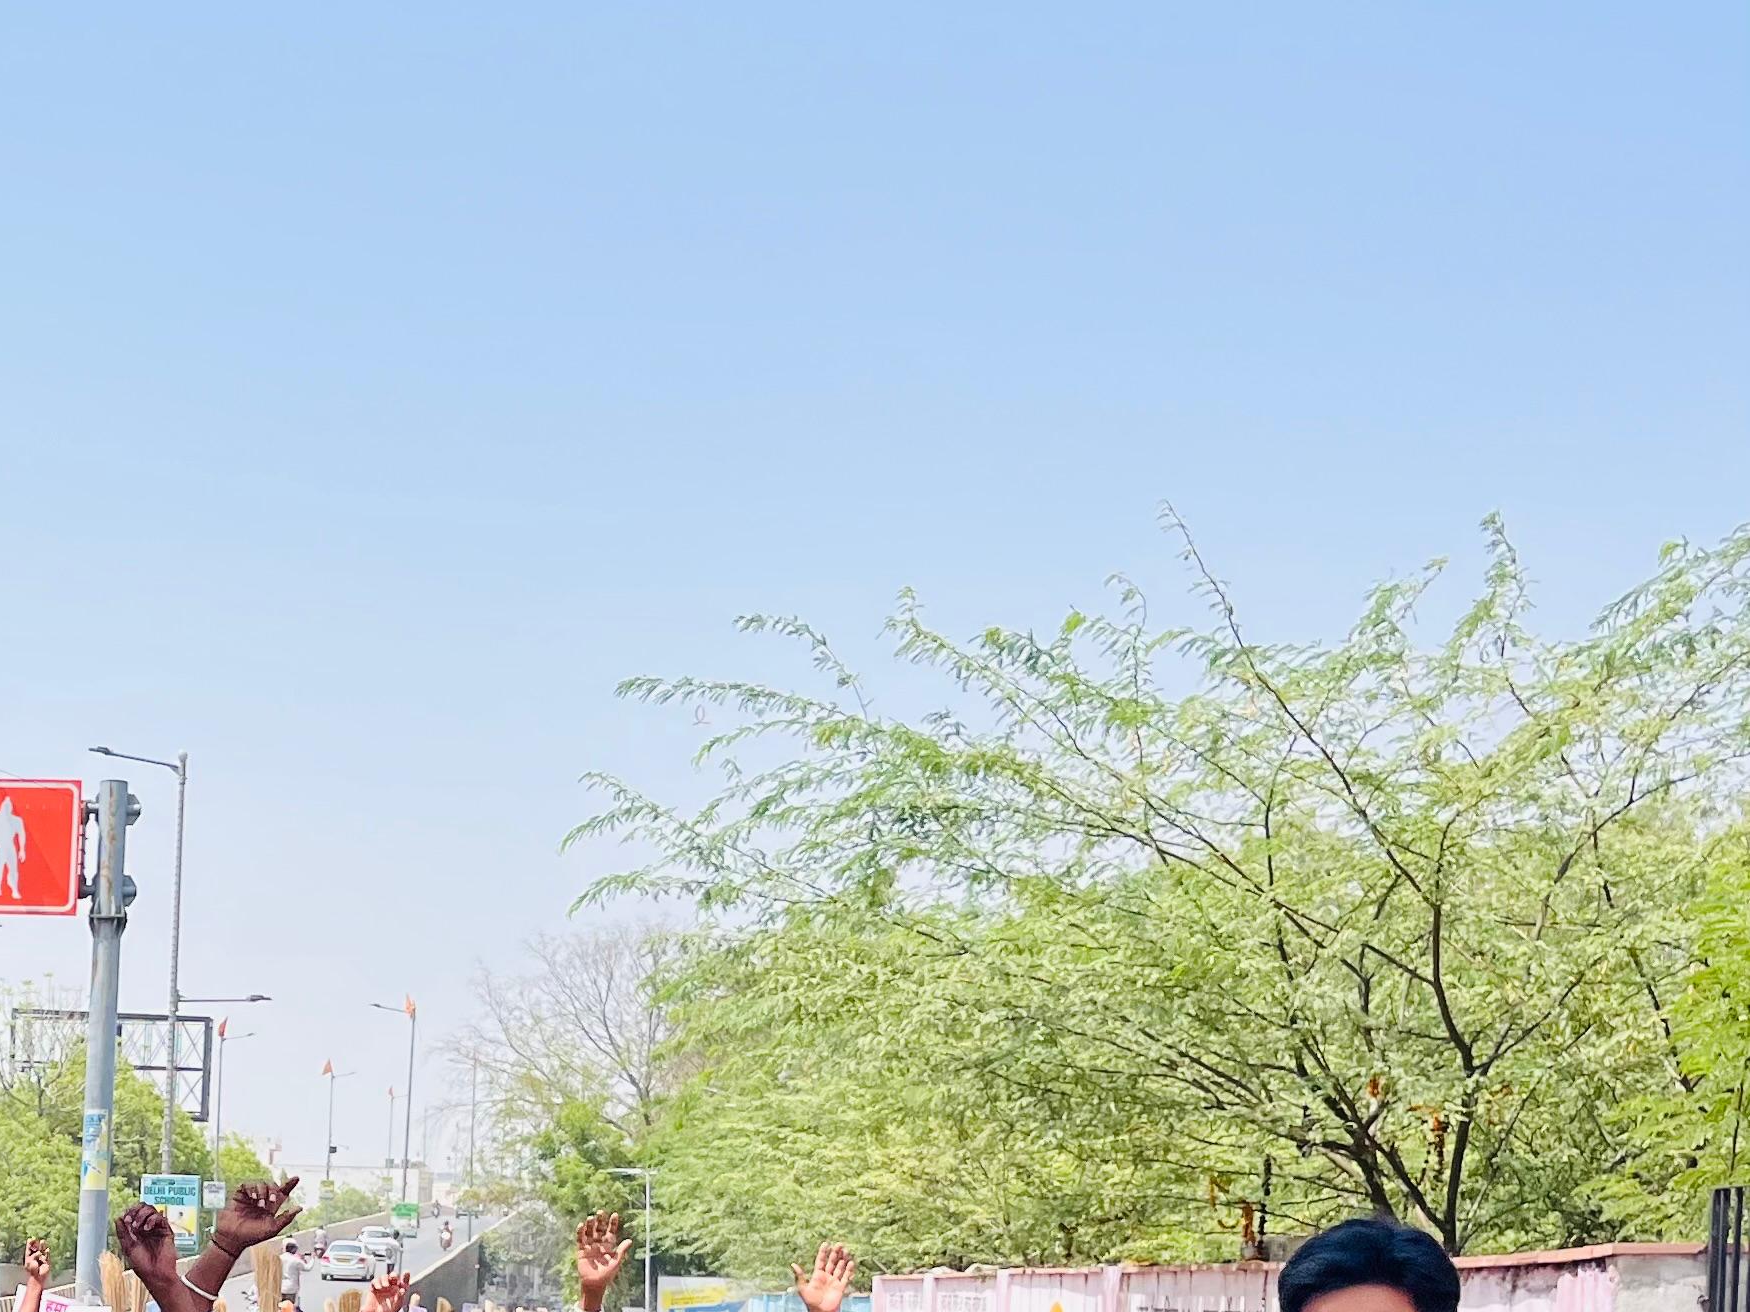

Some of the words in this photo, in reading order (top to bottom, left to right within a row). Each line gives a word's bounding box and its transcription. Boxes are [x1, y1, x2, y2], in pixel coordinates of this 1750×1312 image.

[143, 1186, 166, 1195] DELHI
[168, 1186, 196, 1196] PUBLIC
[154, 1196, 185, 1205] SCHOOL
